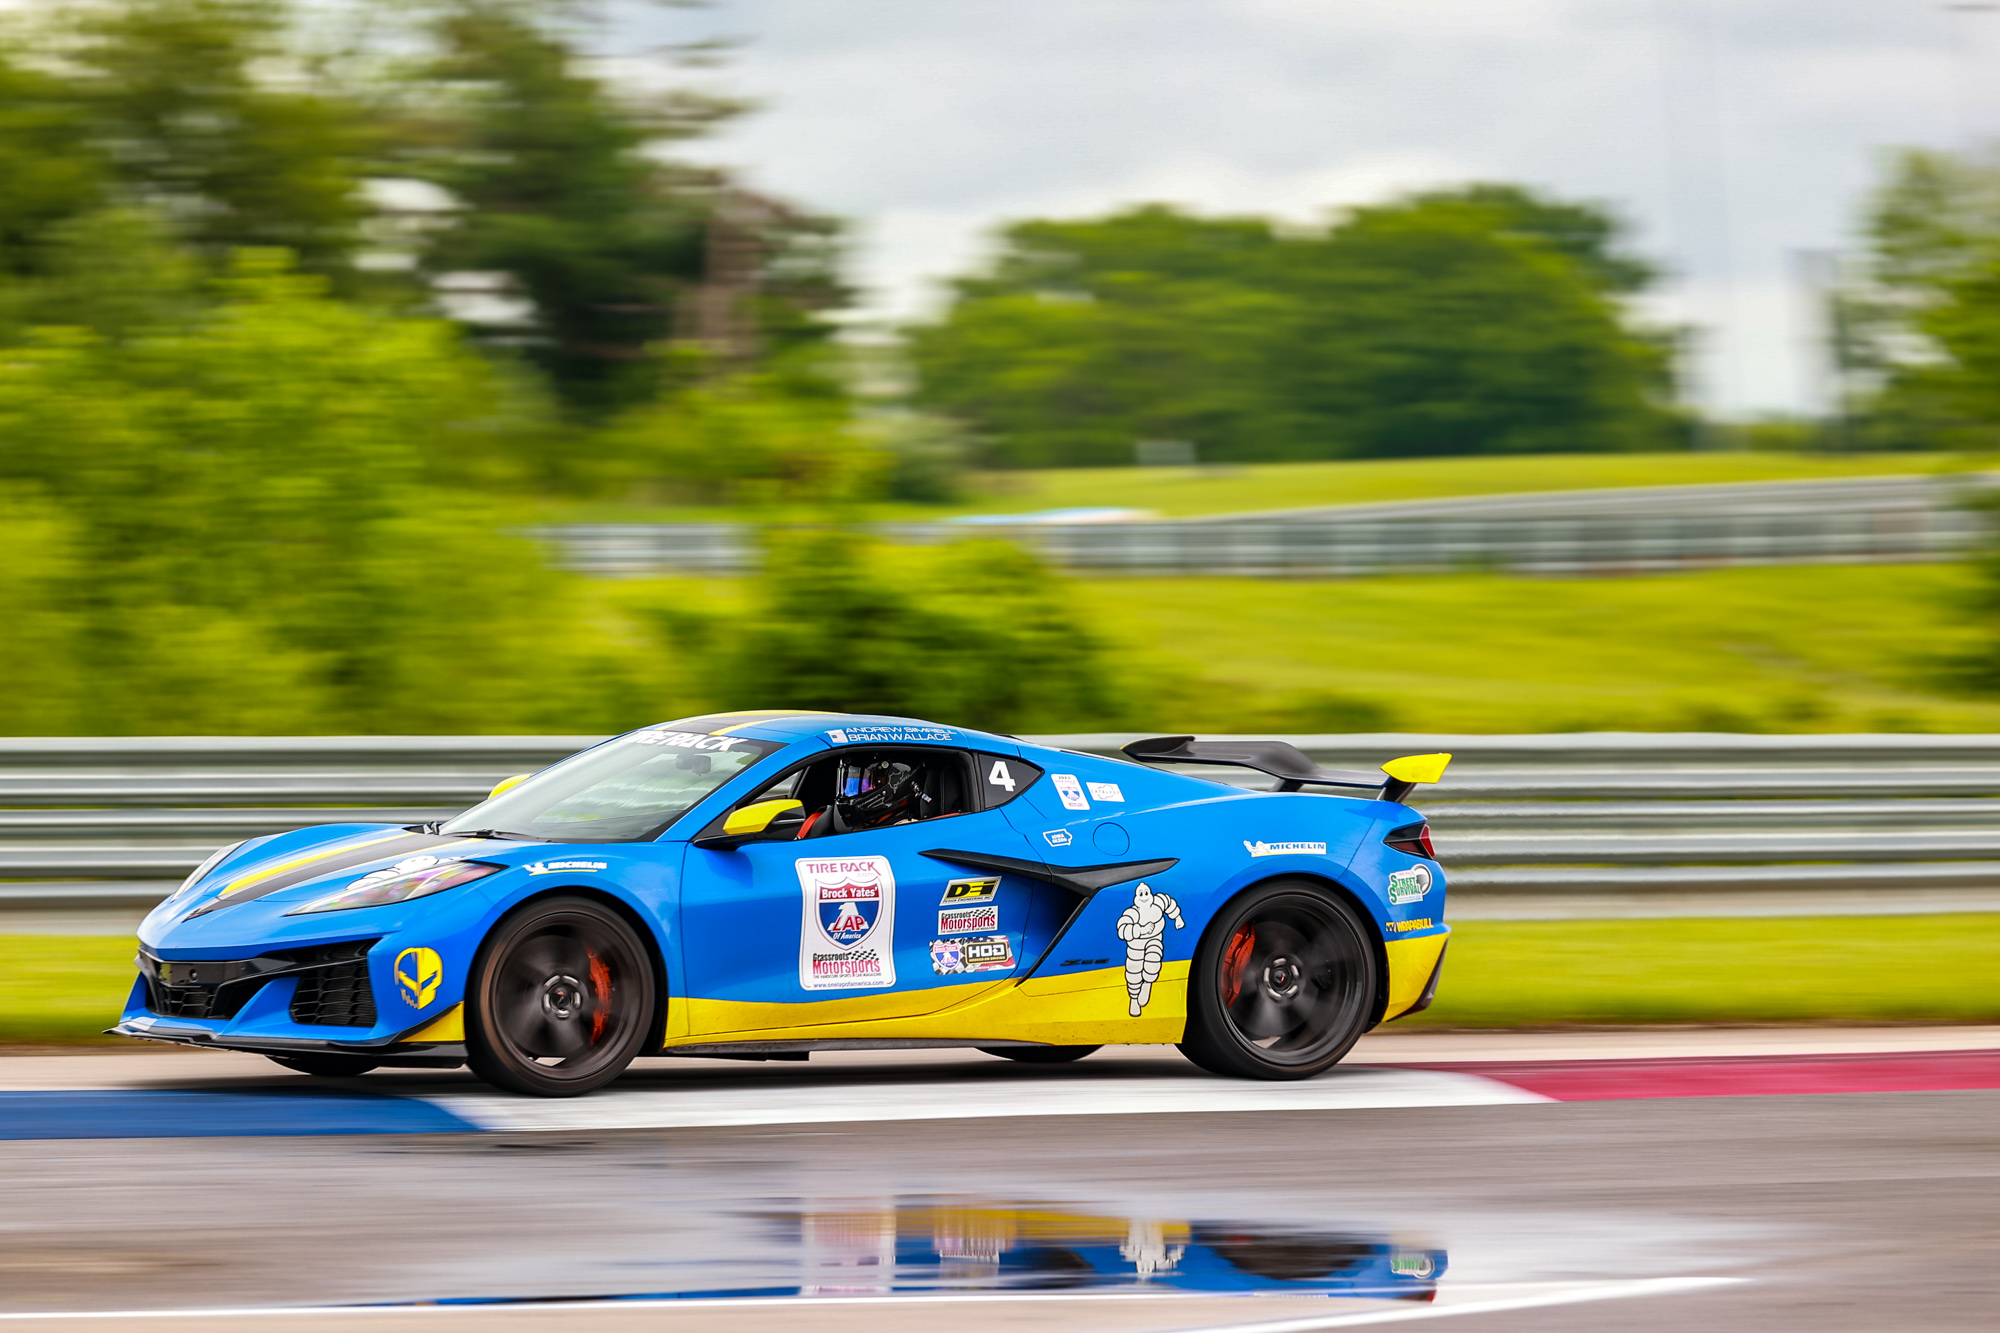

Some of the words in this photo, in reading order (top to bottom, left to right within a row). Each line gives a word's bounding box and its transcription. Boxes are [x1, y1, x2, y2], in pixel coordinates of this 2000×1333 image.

[665, 733, 748, 751] RACK
[848, 733, 888, 742] BRIAN
[889, 733, 952, 741] WALLACE
[988, 760, 1016, 792] 4
[547, 861, 607, 869] MICHELIN
[806, 863, 838, 874] TIRE
[840, 861, 882, 876] RACK
[1390, 875, 1416, 888] STREET
[821, 888, 848, 899] Brock
[849, 886, 878, 898] Yates'
[1389, 885, 1421, 903] SURVIVAL
[941, 911, 971, 919] Grassroots
[831, 915, 866, 932] LAP
[940, 915, 996, 931] Motorsports
[840, 932, 862, 940] America
[812, 953, 850, 961] Grassroots
[968, 944, 1005, 958] HOD
[812, 958, 881, 977] Motorsports
